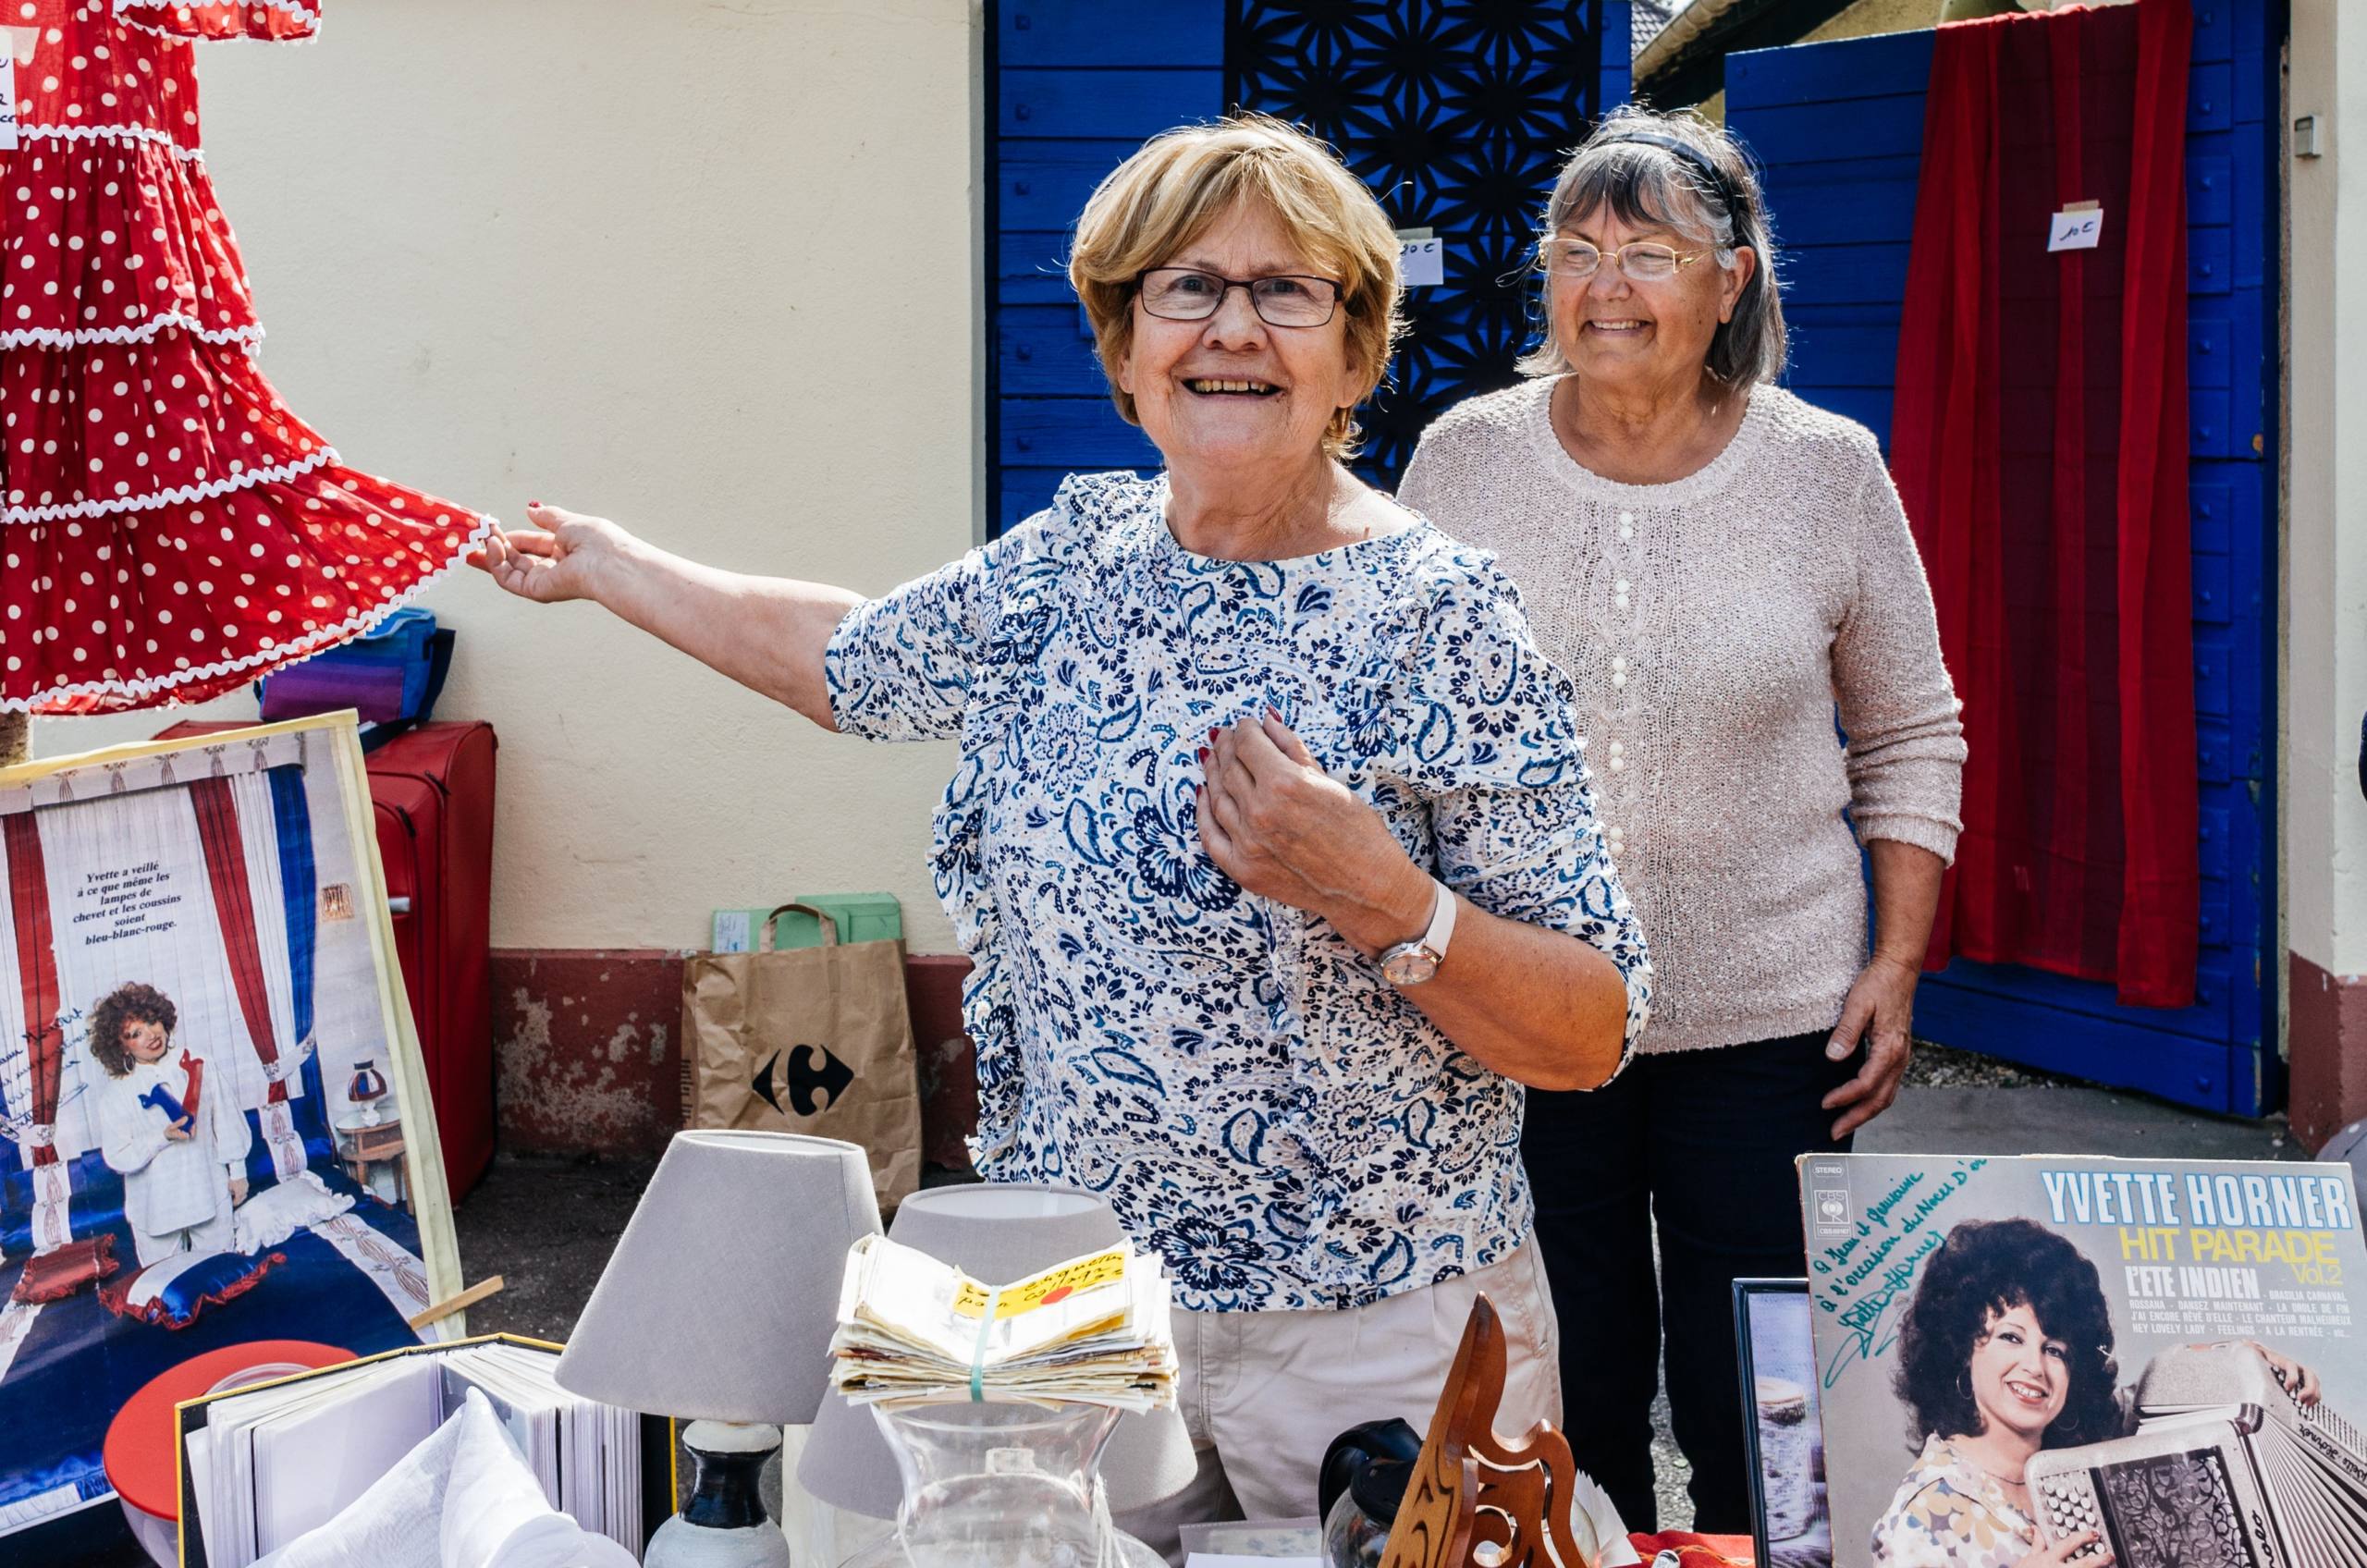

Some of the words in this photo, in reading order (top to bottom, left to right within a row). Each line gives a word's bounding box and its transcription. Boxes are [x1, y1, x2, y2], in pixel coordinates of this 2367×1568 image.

[86, 870, 119, 883] Yvette
[122, 868, 129, 876] a
[131, 860, 159, 875] veillé
[77, 888, 83, 898] à
[87, 887, 98, 896] ce
[101, 883, 120, 895] que
[123, 876, 153, 888] même
[156, 873, 170, 882] les
[100, 890, 137, 905] lampes
[140, 888, 152, 897] de
[72, 910, 105, 923] chevet
[109, 907, 118, 916] et
[122, 903, 137, 913] les
[139, 895, 181, 910] coussins
[114, 913, 145, 927] soient
[85, 920, 177, 945] bleu-blanc-rouge.
[1814, 1166, 1843, 1174] STEREO
[1818, 1191, 1845, 1201] CBS
[2041, 1171, 2181, 1226] YVETTE
[2184, 1173, 2353, 1230] HORNER
[2119, 1227, 2180, 1261] HIT
[2189, 1229, 2340, 1265] PARADE
[2125, 1266, 2177, 1298] L'ETE
[2178, 1267, 2262, 1300] INDIEN
[2306, 1291, 2348, 1302] CARNAVAL
[2128, 1299, 2165, 1310] ROSSANA
[2177, 1301, 2209, 1311] DANSEZ
[2213, 1301, 2264, 1312] MAINTENANT
[2275, 1302, 2288, 1313] LA
[2149, 1311, 2181, 1322] ENCORE
[2241, 1313, 2254, 1324] LE
[2255, 1313, 2298, 1325] CHANTEUR
[2299, 1314, 2353, 1326] MALHEUREUX
[2132, 1323, 2149, 1333] HEY
[2151, 1323, 2181, 1334] LOVELY
[2184, 1324, 2206, 1335] LADY
[2217, 1325, 2256, 1336] FEELINGS
[2275, 1326, 2287, 1337] LA
